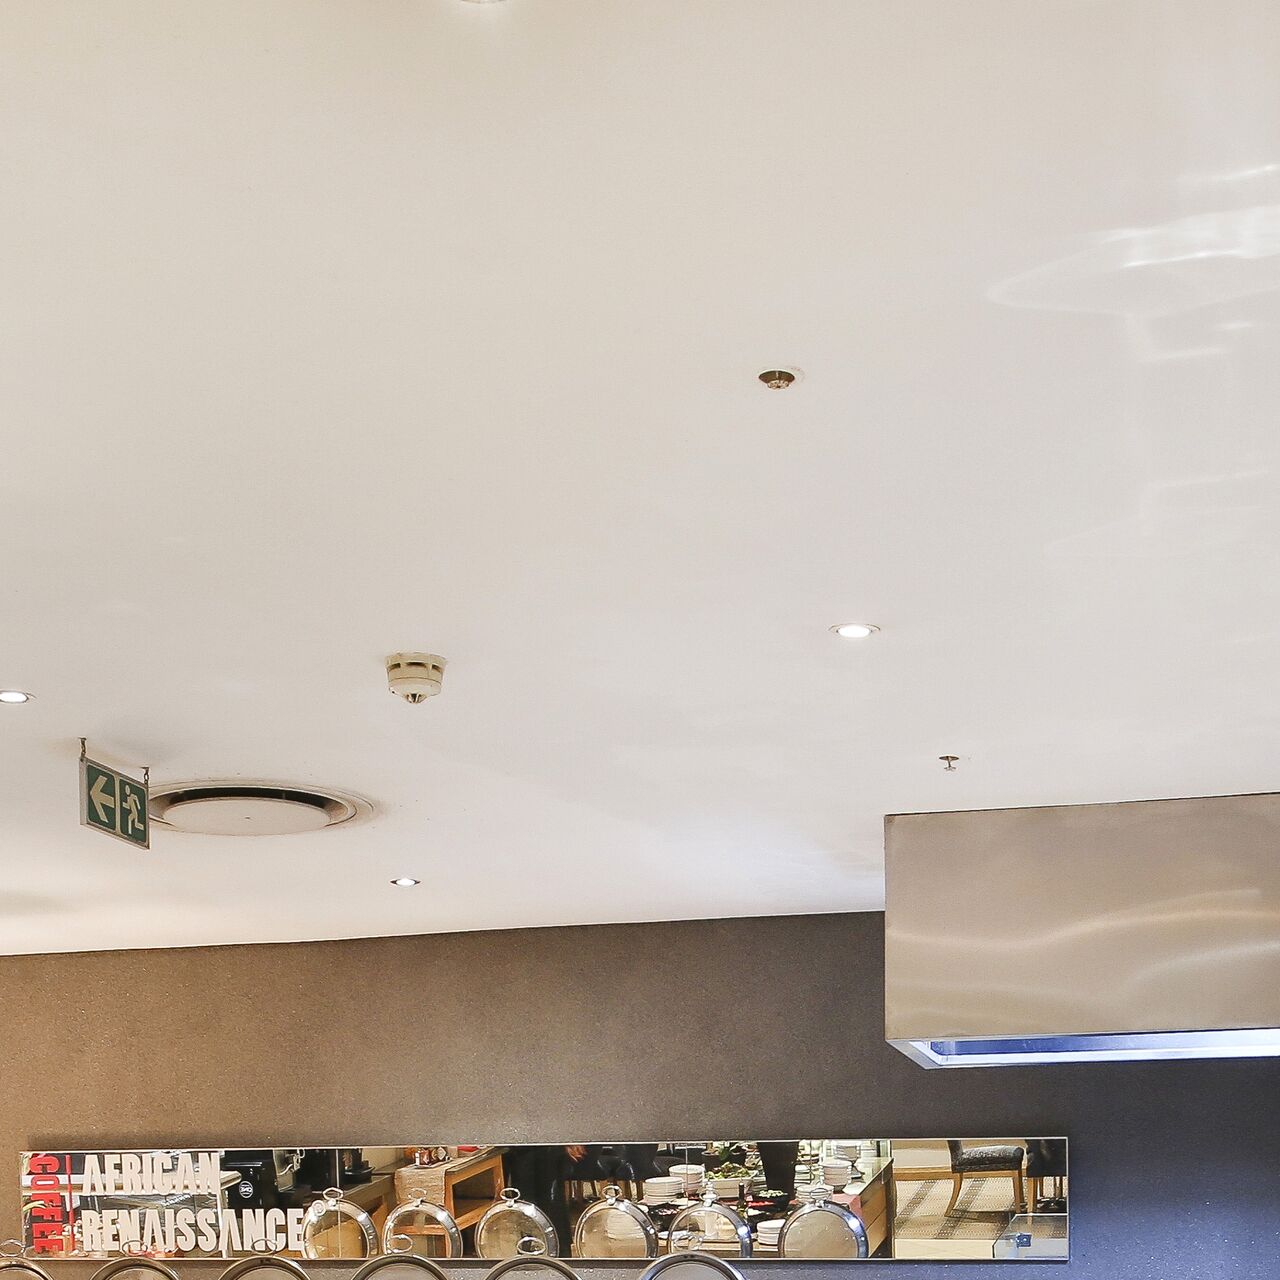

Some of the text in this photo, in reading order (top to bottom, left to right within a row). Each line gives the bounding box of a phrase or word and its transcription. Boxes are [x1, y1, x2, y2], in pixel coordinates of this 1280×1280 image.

[81, 1154, 221, 1195] AFRICAN
[30, 1153, 64, 1254] COFFEE
[81, 1208, 304, 1252] RENAISSANCE
